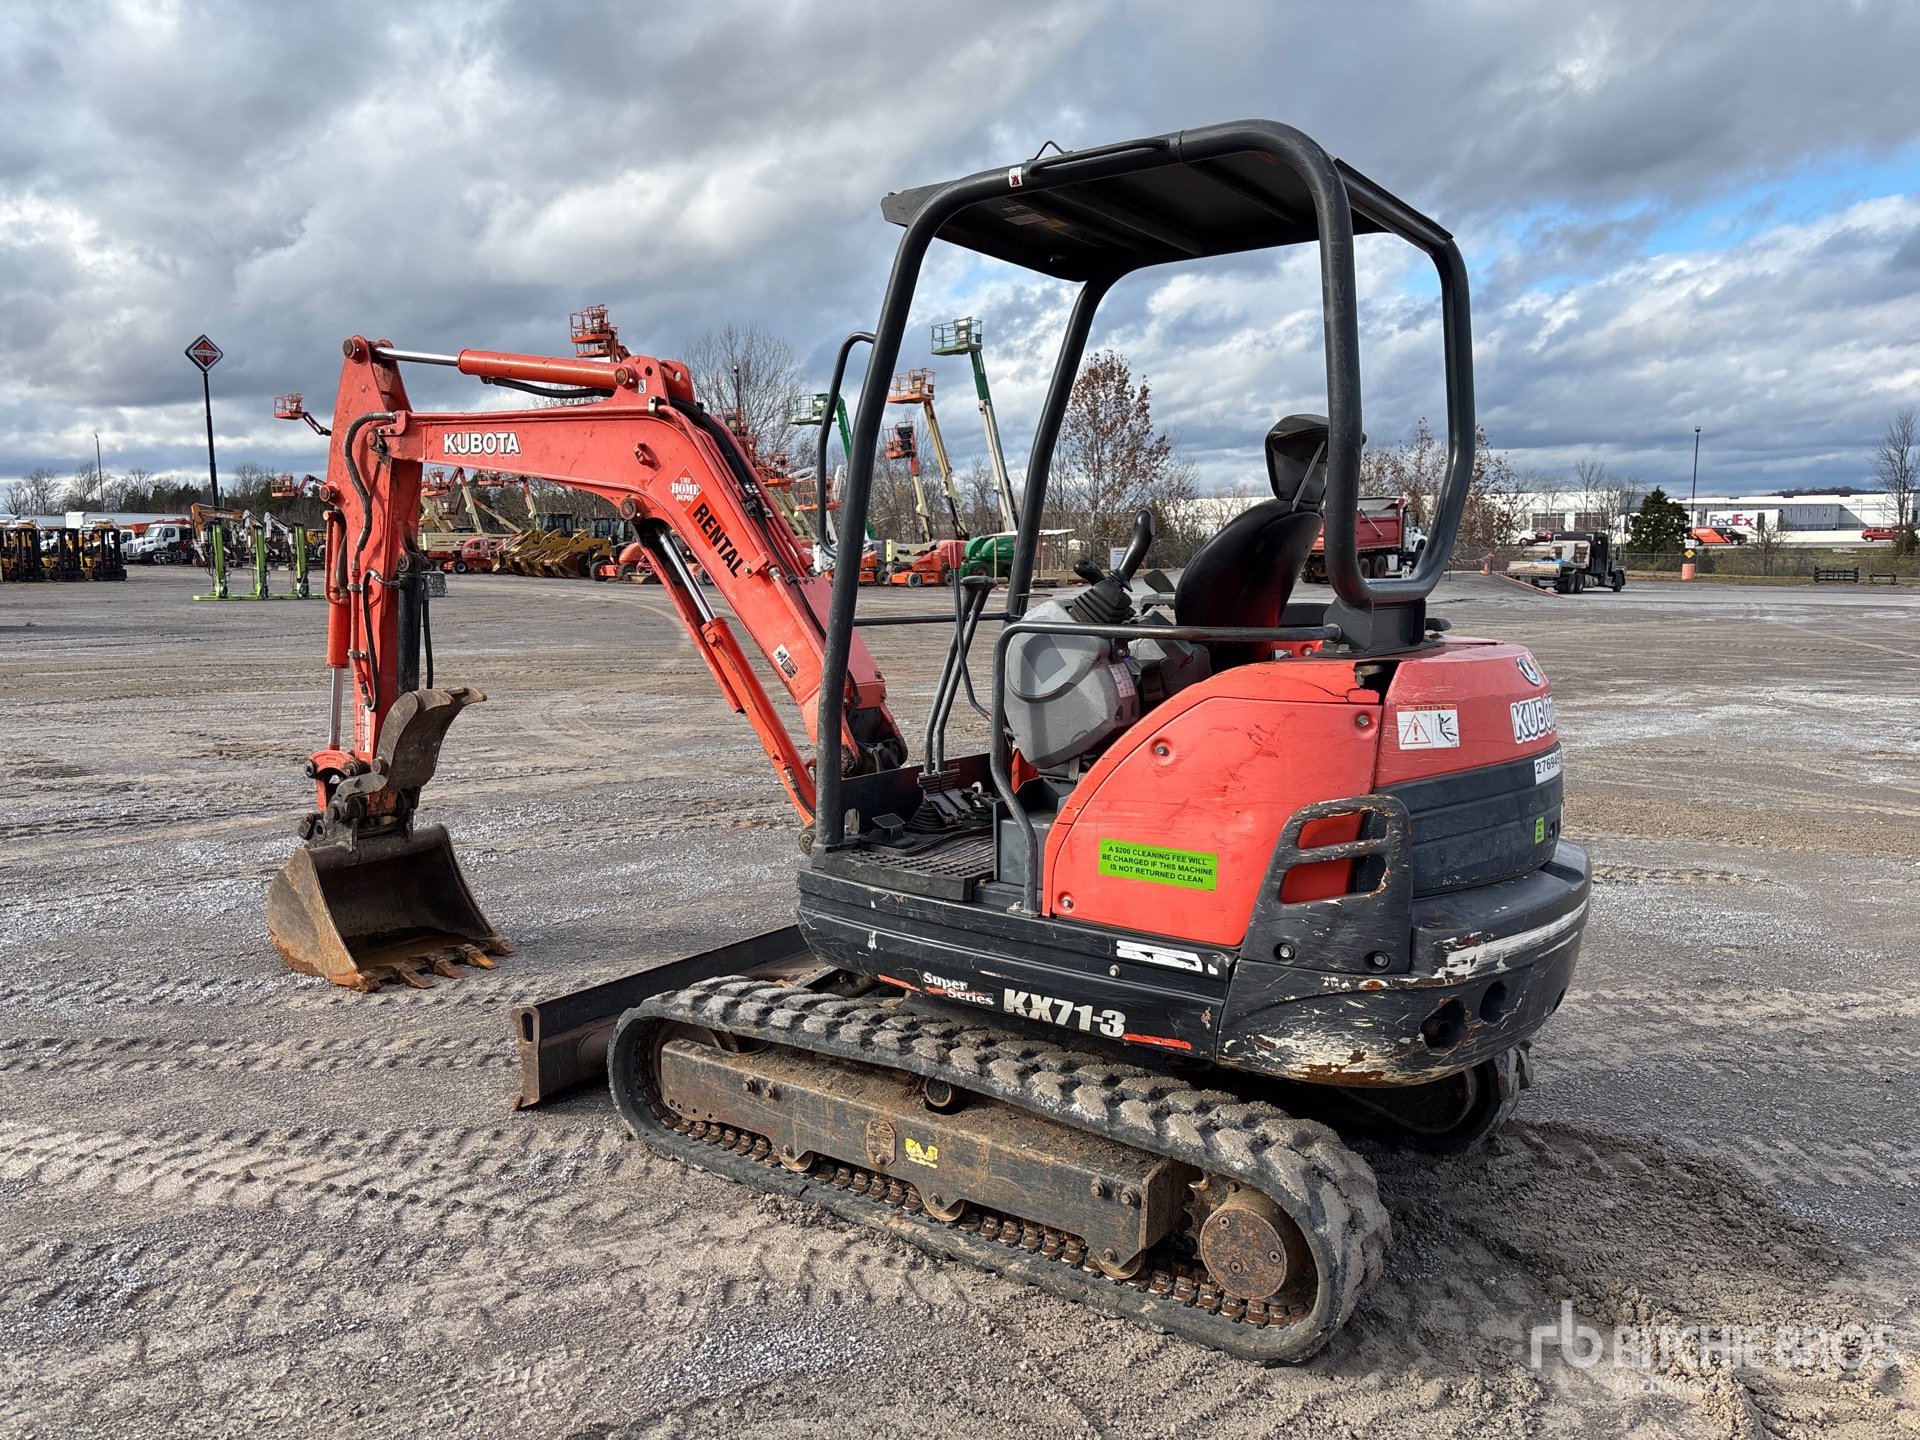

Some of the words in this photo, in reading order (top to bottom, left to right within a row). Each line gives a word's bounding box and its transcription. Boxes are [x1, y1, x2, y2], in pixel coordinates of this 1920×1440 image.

[443, 432, 521, 455] KUBOTA
[671, 483, 700, 494] HOME
[676, 494, 695, 502] DEPOT
[1709, 513, 1754, 527] FedEx
[693, 502, 744, 578] RENTAL
[1113, 855, 1149, 867] CHARGED
[1160, 862, 1176, 870] THIS
[1178, 865, 1213, 876] MACHINE
[1115, 846, 1131, 854] $200
[1132, 849, 1170, 860] CLEANING
[1171, 854, 1187, 863] FEE
[1188, 857, 1207, 866] WILL
[1118, 865, 1133, 873] NOT
[1135, 868, 1176, 879] RETURNED
[1177, 874, 1204, 883] CLEAN
[923, 970, 968, 991] Super
[947, 988, 995, 1006] Series
[1003, 987, 1126, 1038] KX71-3
